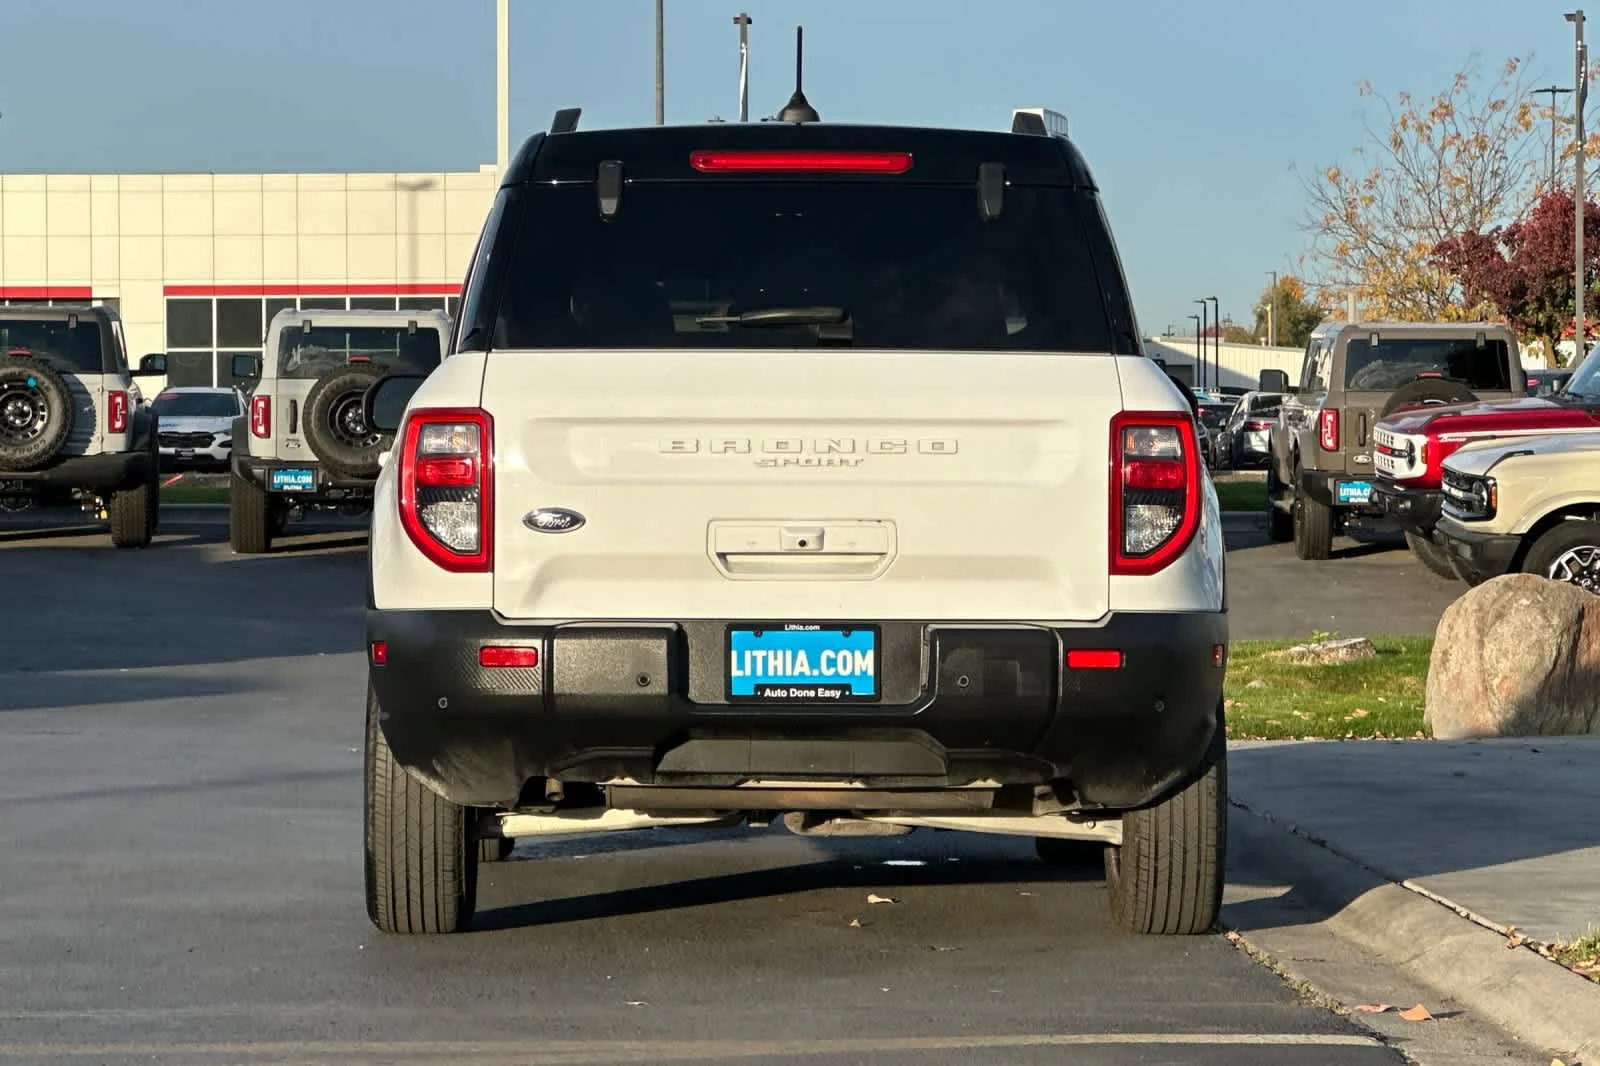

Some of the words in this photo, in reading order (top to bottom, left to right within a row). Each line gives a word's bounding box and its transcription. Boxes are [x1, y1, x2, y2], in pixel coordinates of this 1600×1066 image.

[659, 438, 959, 454] BRONCO
[754, 457, 864, 468] SPORT
[731, 649, 874, 677] LITHIA.COM
[763, 688, 788, 698] Auto
[789, 688, 815, 698] Done
[817, 688, 841, 699] Easy
